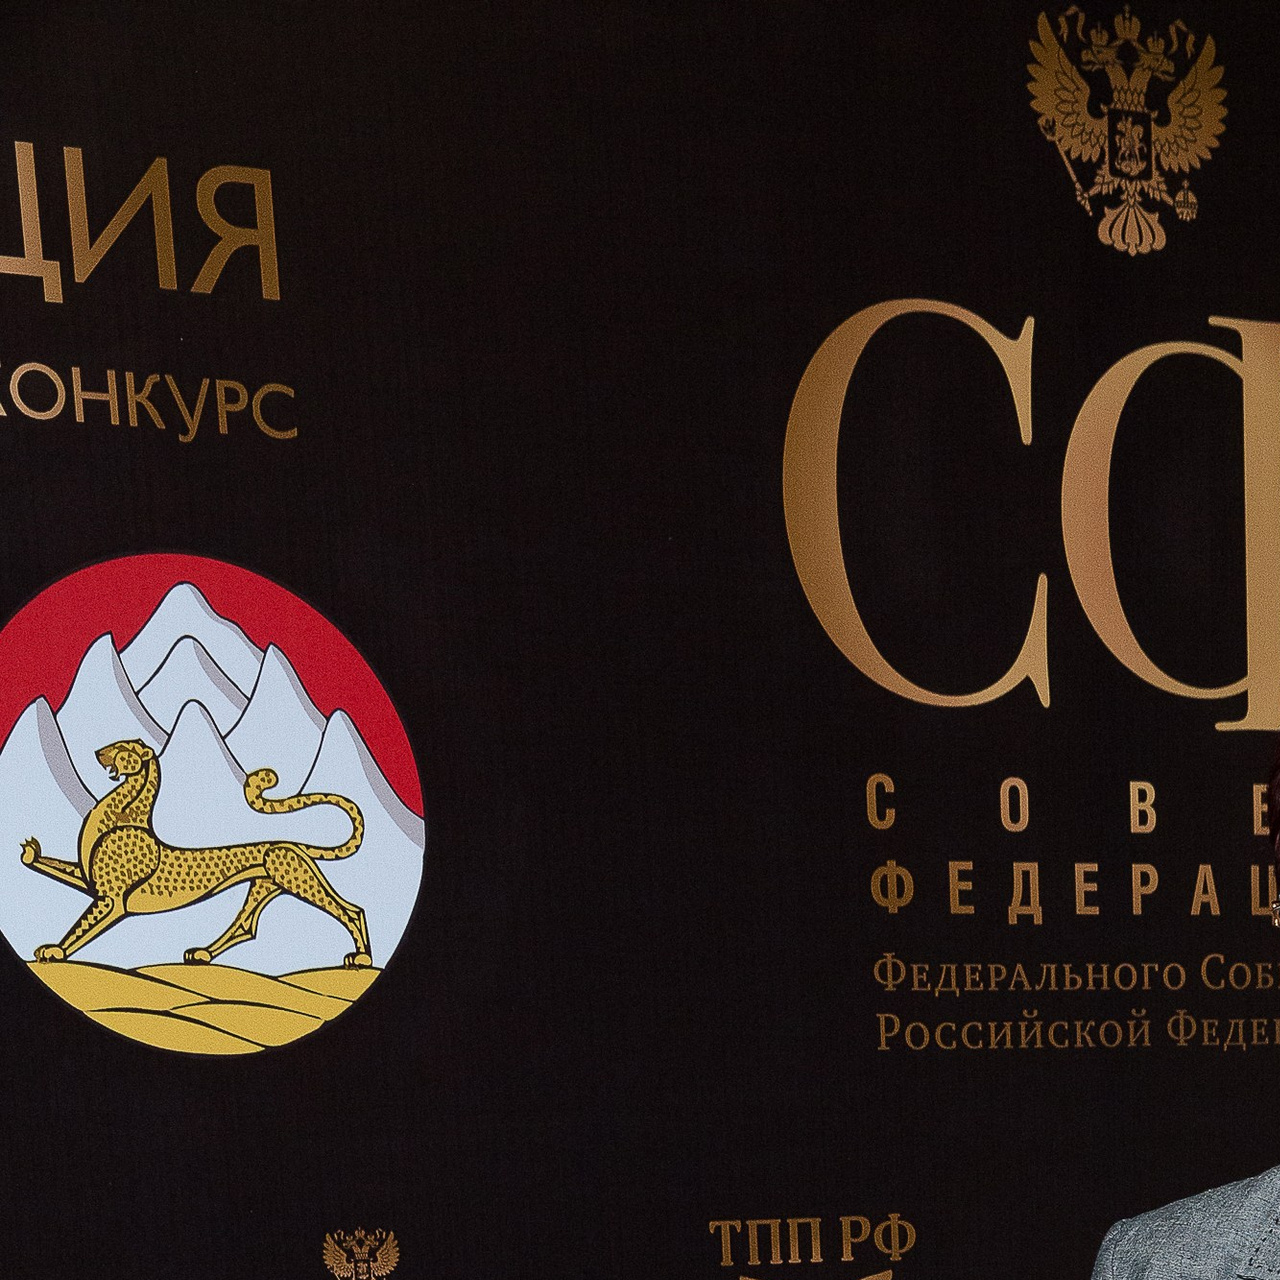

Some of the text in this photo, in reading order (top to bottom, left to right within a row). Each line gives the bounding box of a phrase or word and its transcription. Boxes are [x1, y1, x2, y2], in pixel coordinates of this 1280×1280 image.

[0, 360, 298, 443] ОНКУРС
[709, 1212, 917, 1267] ТПП РФ
